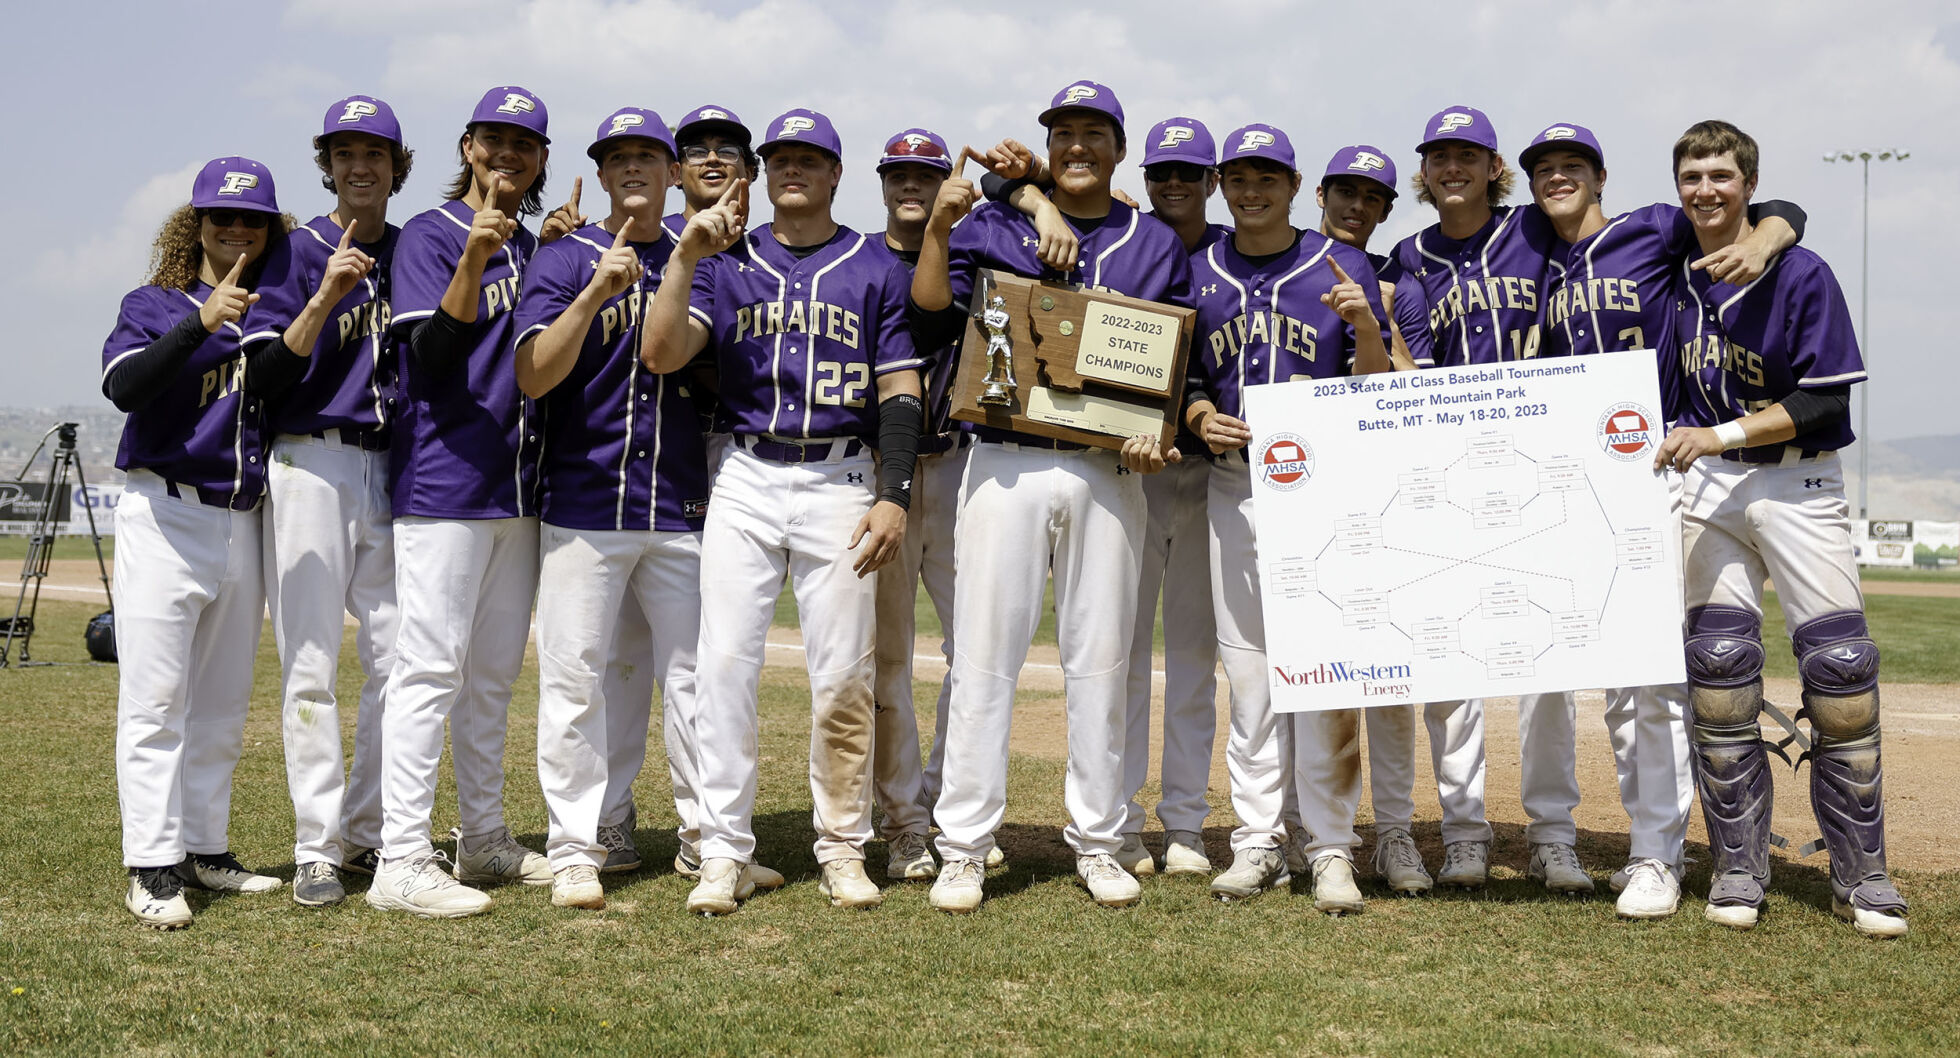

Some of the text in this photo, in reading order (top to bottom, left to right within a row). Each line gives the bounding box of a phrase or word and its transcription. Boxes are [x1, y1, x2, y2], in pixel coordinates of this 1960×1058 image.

[496, 94, 536, 115] P
[1061, 85, 1098, 106] P
[338, 100, 378, 124] P
[1436, 112, 1474, 135] P
[608, 113, 645, 137] P
[777, 116, 815, 139] P
[1158, 126, 1195, 149] P
[1237, 130, 1275, 153] P
[1347, 152, 1385, 172] P
[217, 171, 258, 196] P
[1430, 276, 1537, 343] PIRATES
[1546, 277, 1641, 330] IRATES
[734, 300, 860, 350] PIRATES
[1101, 314, 1163, 336] 2022-2023
[1108, 336, 1149, 354] STATE
[1209, 311, 1318, 369] PIRATES
[1085, 354, 1164, 379] CHAMPIONS
[1681, 334, 1765, 388] IRATES
[815, 361, 870, 409] 22
[1314, 363, 1586, 397] 2023 State All Class Baseball Tournament
[1376, 386, 1525, 412] Copper Mountain Park
[1359, 420, 1397, 431] Butte,
[1403, 415, 1423, 427] MT
[1437, 413, 1464, 425] May
[1470, 408, 1509, 420] 18-20,
[1515, 404, 1547, 417] 2023
[1604, 432, 1653, 452] MHSA
[1263, 462, 1311, 482] MHSA
[1273, 662, 1411, 688] NorthWestern
[1364, 682, 1411, 699] Energy
